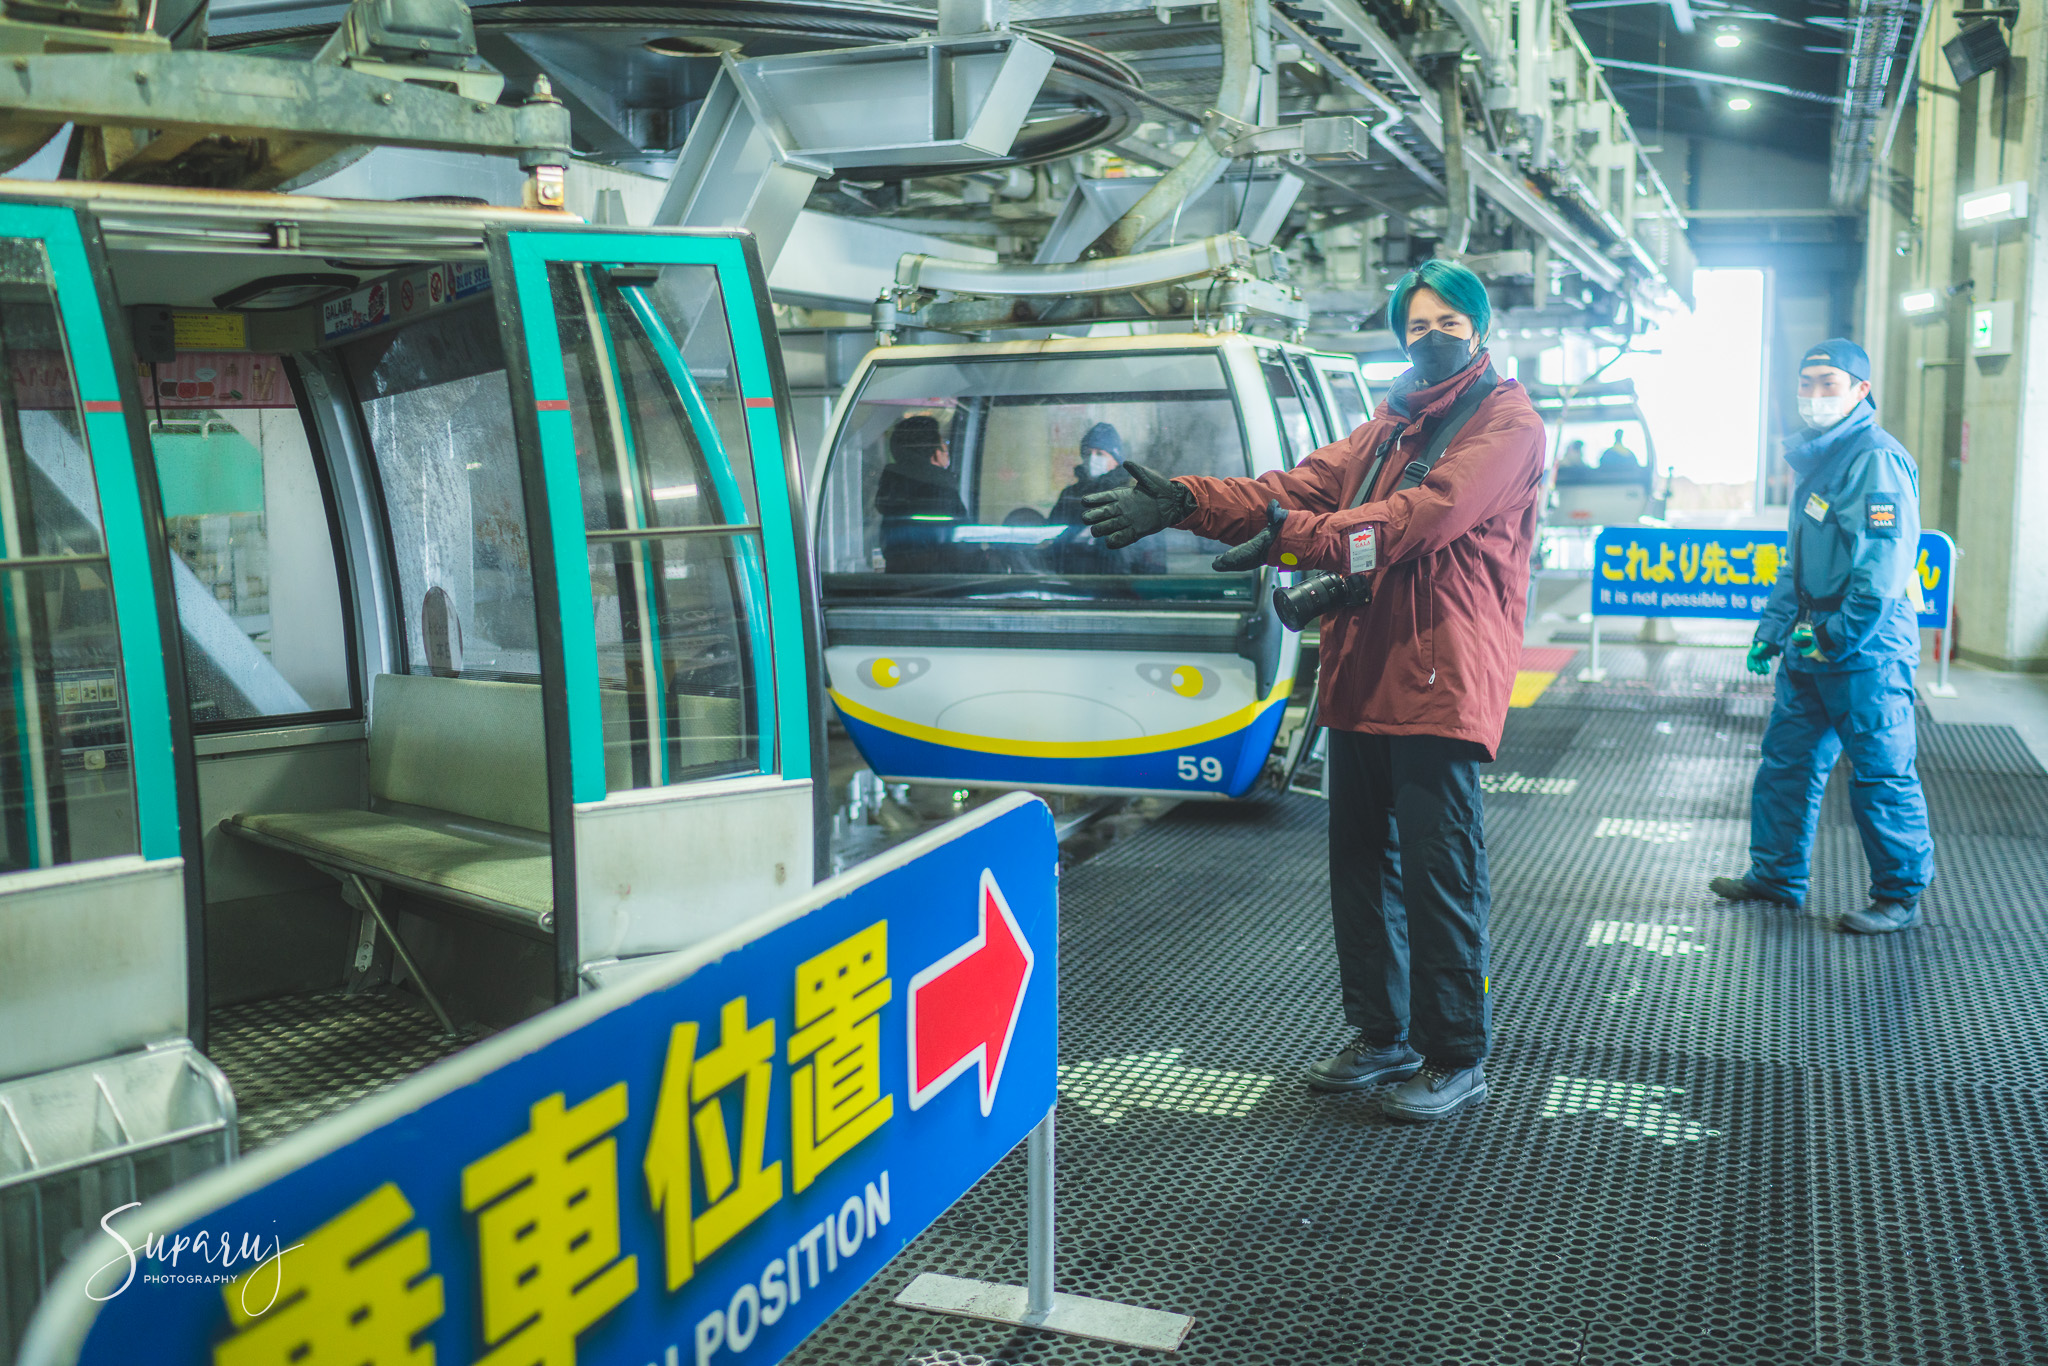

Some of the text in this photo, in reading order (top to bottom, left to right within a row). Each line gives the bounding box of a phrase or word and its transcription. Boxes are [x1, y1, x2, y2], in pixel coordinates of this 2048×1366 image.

[1600, 588, 1611, 604] It
[1614, 589, 1628, 605] is
[1631, 591, 1658, 606] not
[1661, 590, 1728, 609] possible
[1731, 594, 1747, 609] to
[1177, 755, 1223, 783] 59
[695, 1170, 891, 1366] POSITION
